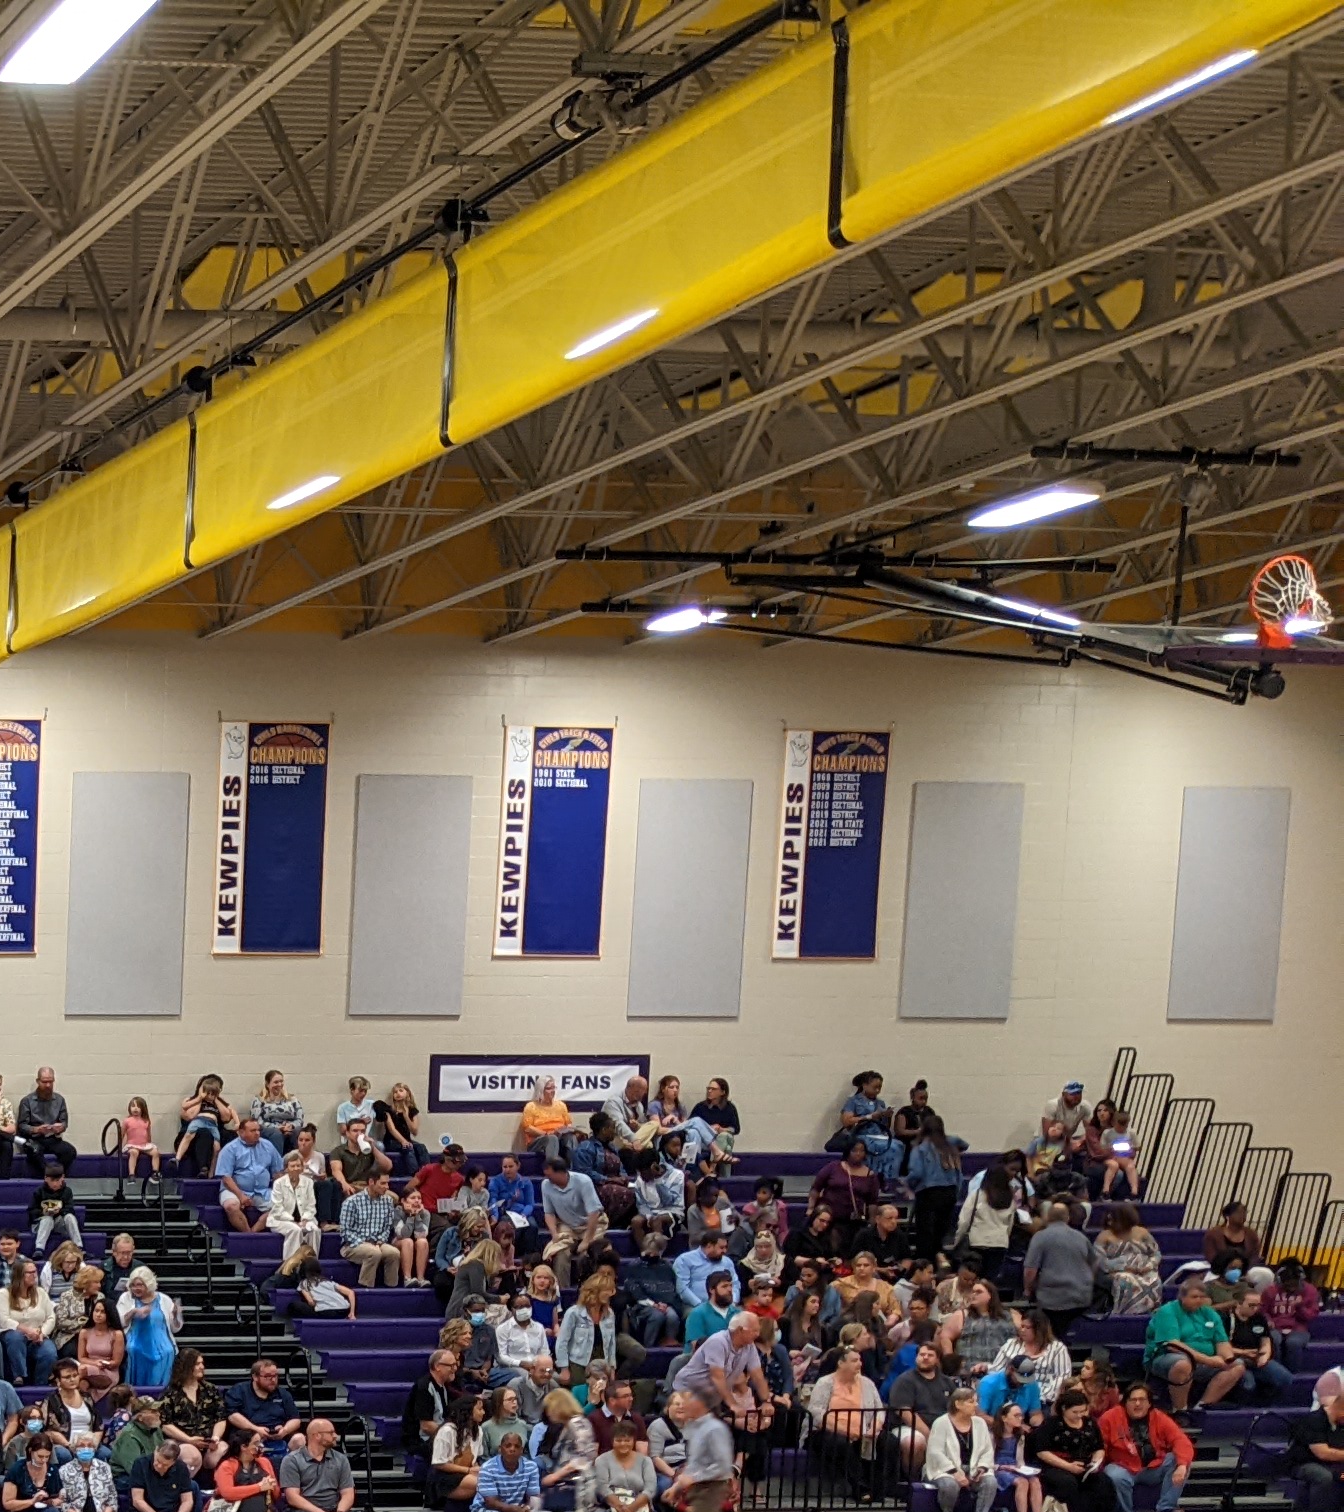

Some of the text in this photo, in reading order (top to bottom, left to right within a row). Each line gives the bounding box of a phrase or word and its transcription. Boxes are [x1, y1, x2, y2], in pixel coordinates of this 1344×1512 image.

[250, 747, 326, 764] CHAMPIONS
[535, 750, 609, 769] CHAMPIONS
[813, 755, 886, 772] CHAMPIONS
[218, 775, 241, 936] KEWPIES
[500, 778, 525, 937] KEWPIES
[777, 783, 804, 940] KEWPIES
[468, 1075, 611, 1089] VISITIN FANS
